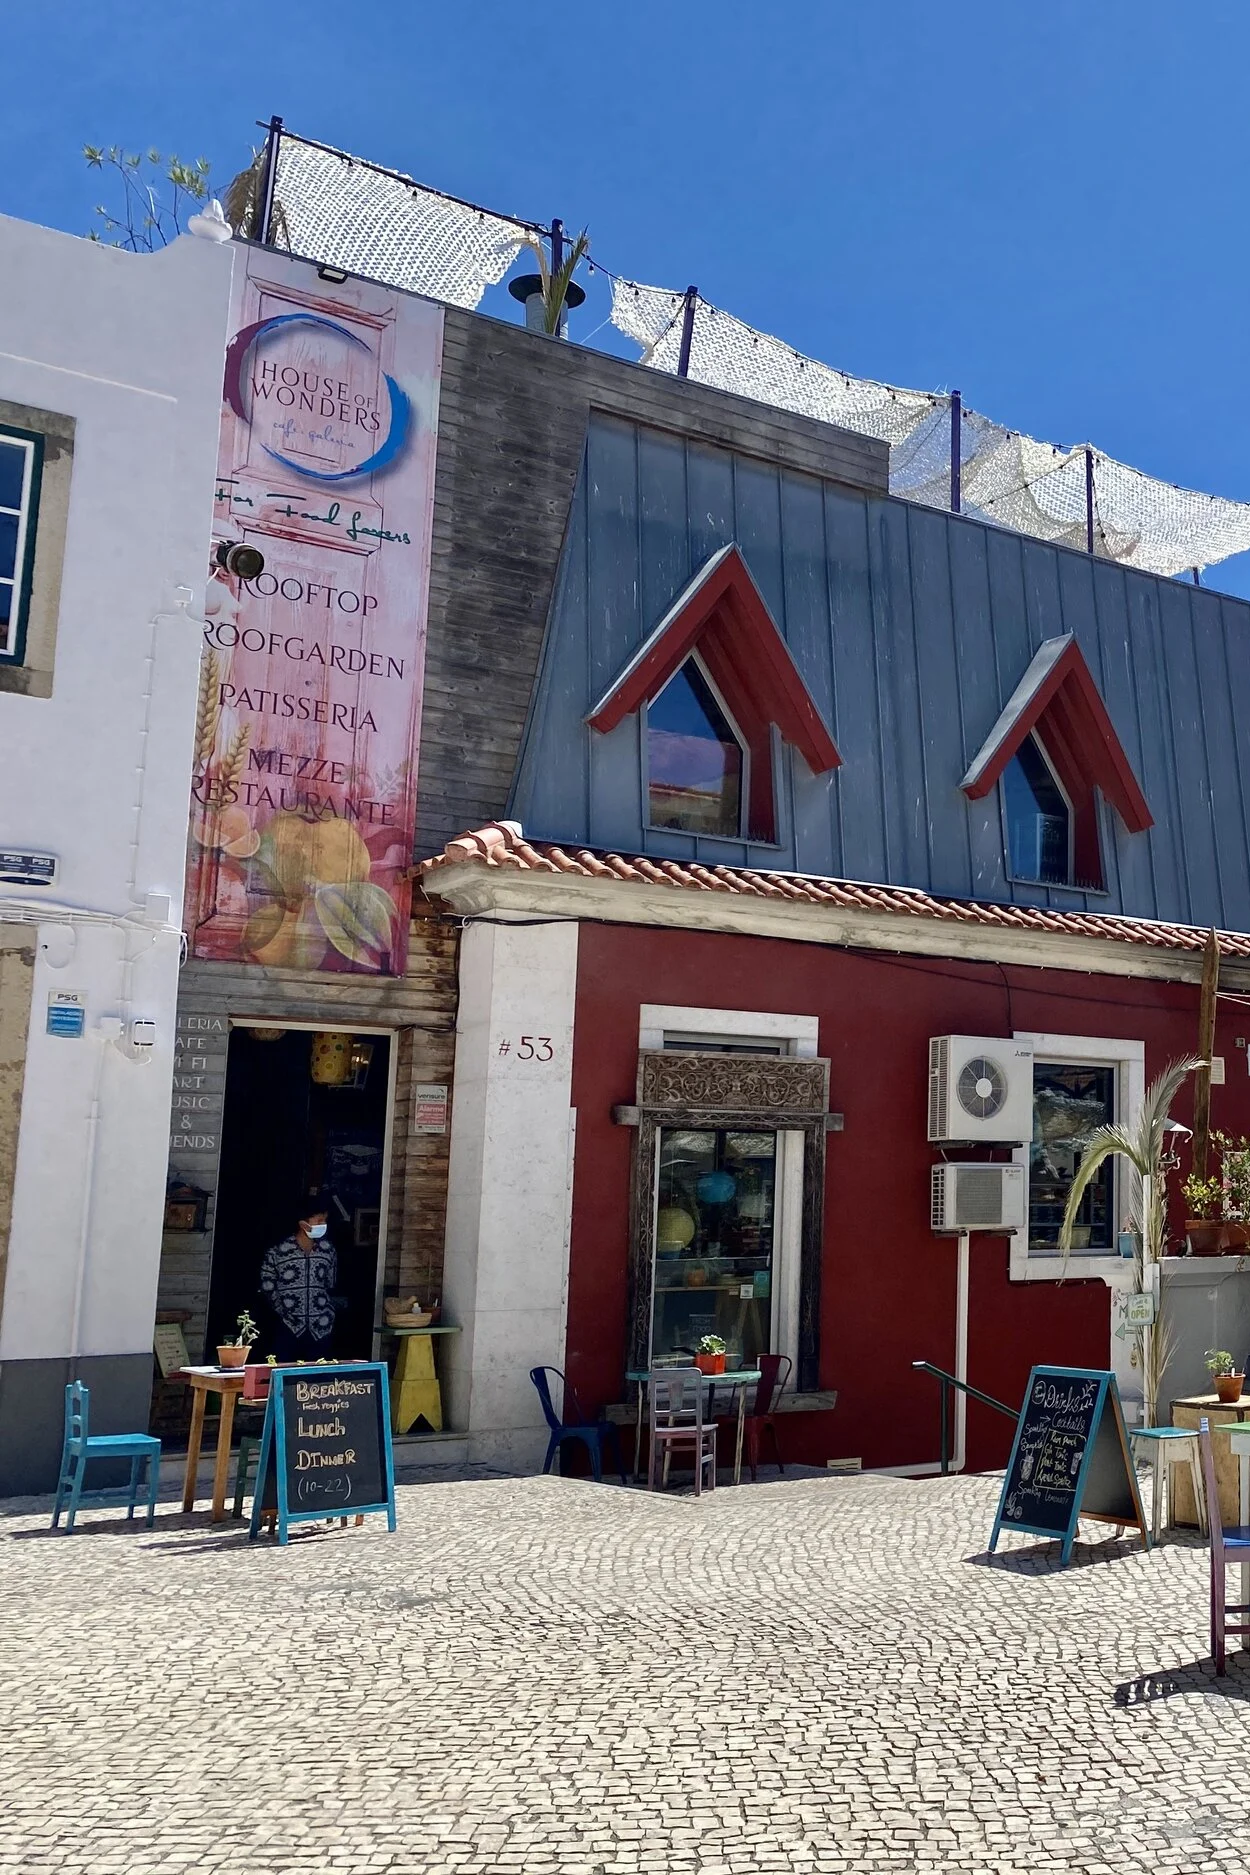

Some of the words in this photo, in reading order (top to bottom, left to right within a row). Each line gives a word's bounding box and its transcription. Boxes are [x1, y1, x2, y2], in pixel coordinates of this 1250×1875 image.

[261, 360, 349, 402] HOUSE
[354, 394, 375, 409] OF
[251, 377, 381, 433] WONDERS
[214, 478, 254, 507] For
[266, 493, 341, 526] Food
[238, 572, 378, 617] ROOFTOP
[203, 619, 405, 680] ROOFGARDEN
[218, 683, 379, 733] PATISSERIA
[247, 748, 345, 785] MEZZE
[190, 775, 396, 826] RESTAURANTE
[57, 993, 78, 1001] PSG
[177, 1016, 223, 1031] LERIA
[175, 1036, 207, 1050] AFE
[191, 1056, 207, 1070] FI
[171, 1095, 210, 1109] USIC
[180, 1114, 192, 1129] &
[1130, 1309, 1150, 1320] OPEN
[296, 1378, 374, 1402] BREAKFAST
[297, 1474, 352, 1500] (10-22)
